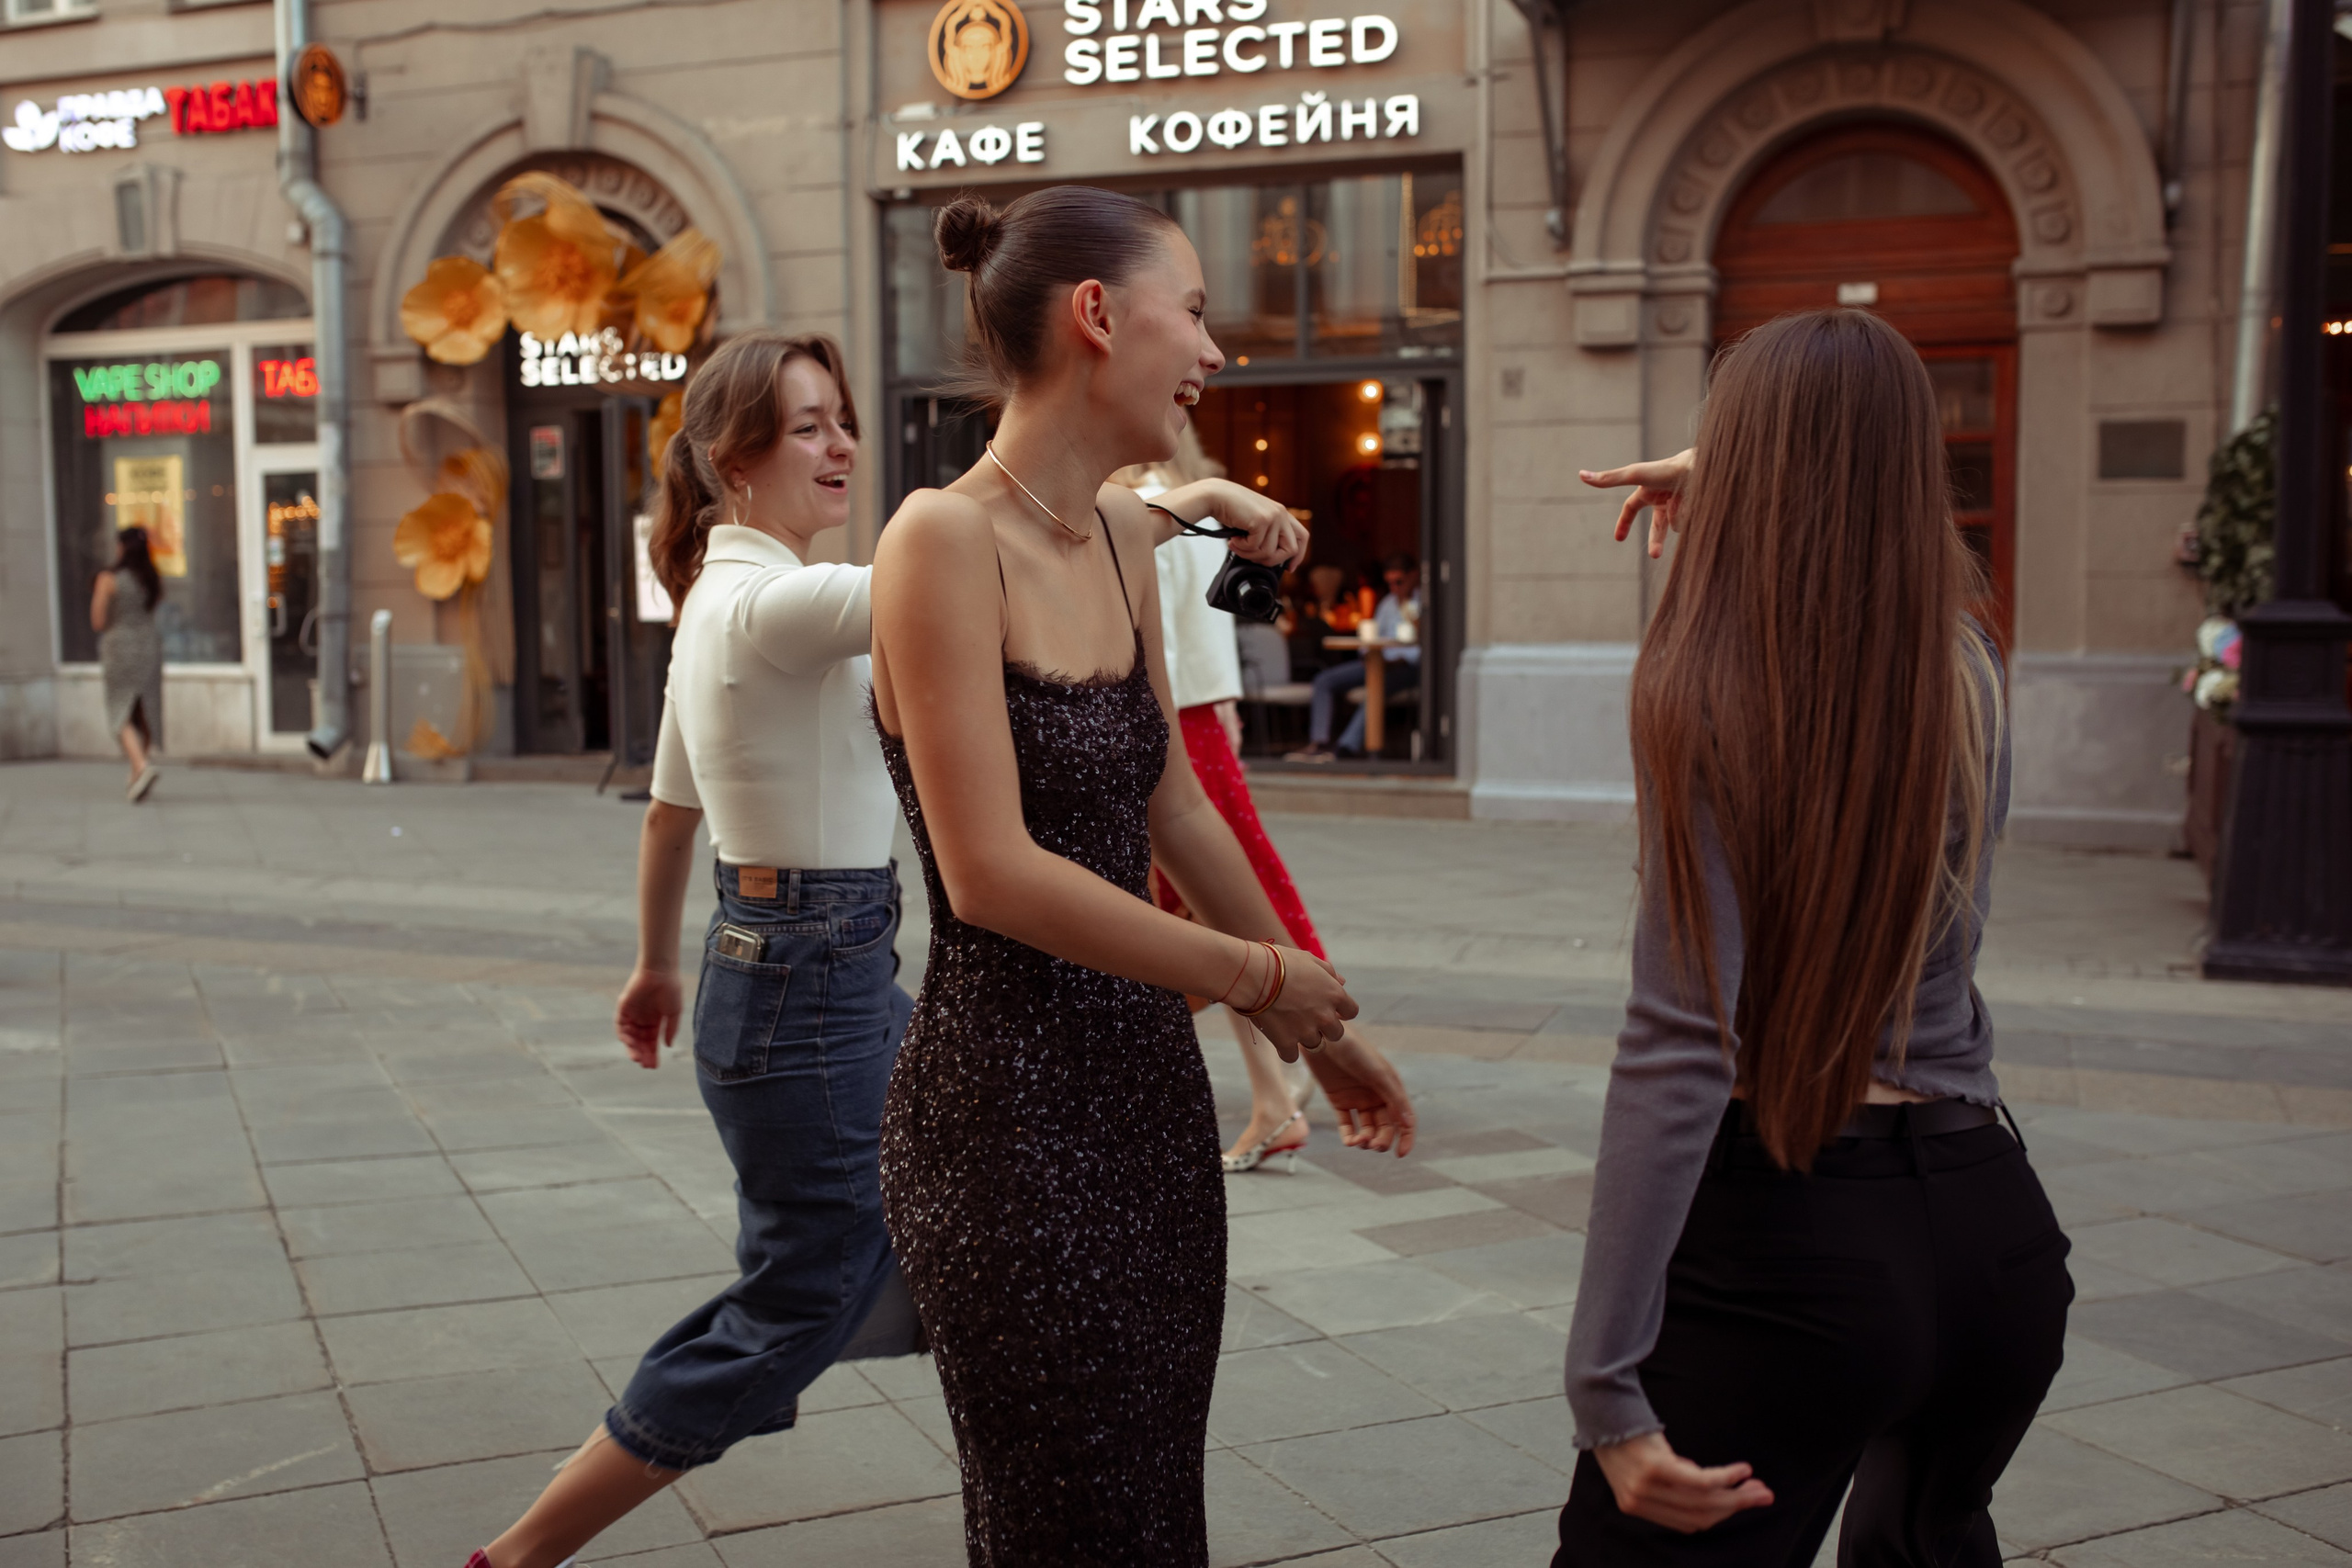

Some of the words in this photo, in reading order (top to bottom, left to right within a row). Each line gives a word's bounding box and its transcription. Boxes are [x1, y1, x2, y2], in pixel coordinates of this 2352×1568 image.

[1063, 14, 1398, 85] SELECTED
[164, 77, 278, 136] ТАБАК
[897, 120, 1046, 172] КАФЕ
[1129, 90, 1420, 156] КОФЕЙНЯ
[73, 363, 144, 402] VAPE
[143, 360, 220, 400] SHOP
[258, 357, 322, 398] ТАБ
